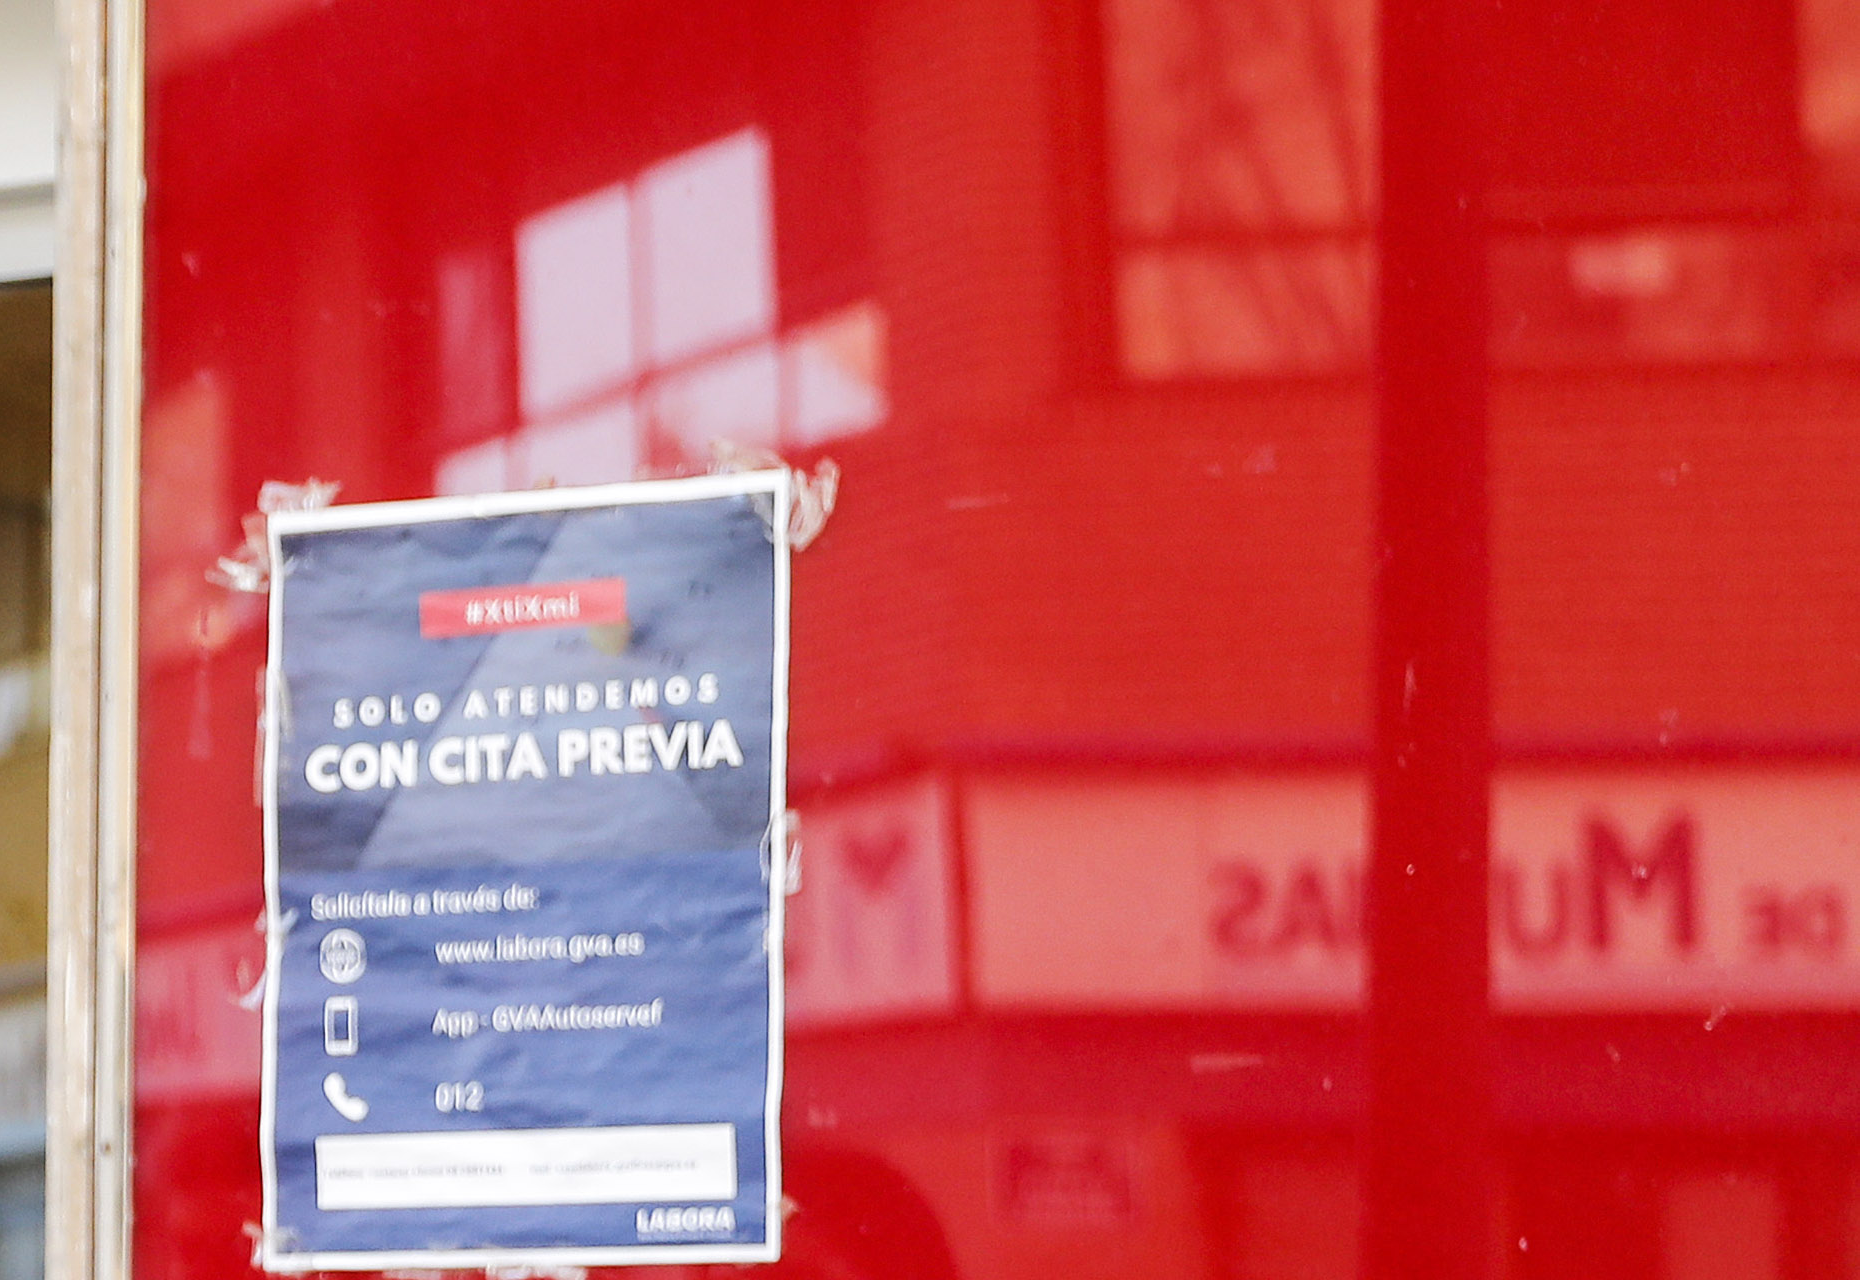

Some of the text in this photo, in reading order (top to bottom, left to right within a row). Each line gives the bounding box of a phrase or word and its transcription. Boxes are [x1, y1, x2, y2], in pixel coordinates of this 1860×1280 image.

[333, 673, 720, 728] SOLO ATENDEMOS
[305, 719, 744, 792] CON CITA PREVIA
[413, 892, 429, 916] a
[432, 884, 501, 914] través
[435, 932, 645, 964] www.labora.gva.es
[432, 1007, 480, 1038] App
[435, 1080, 484, 1113] 012
[636, 1206, 736, 1232] LABORA
